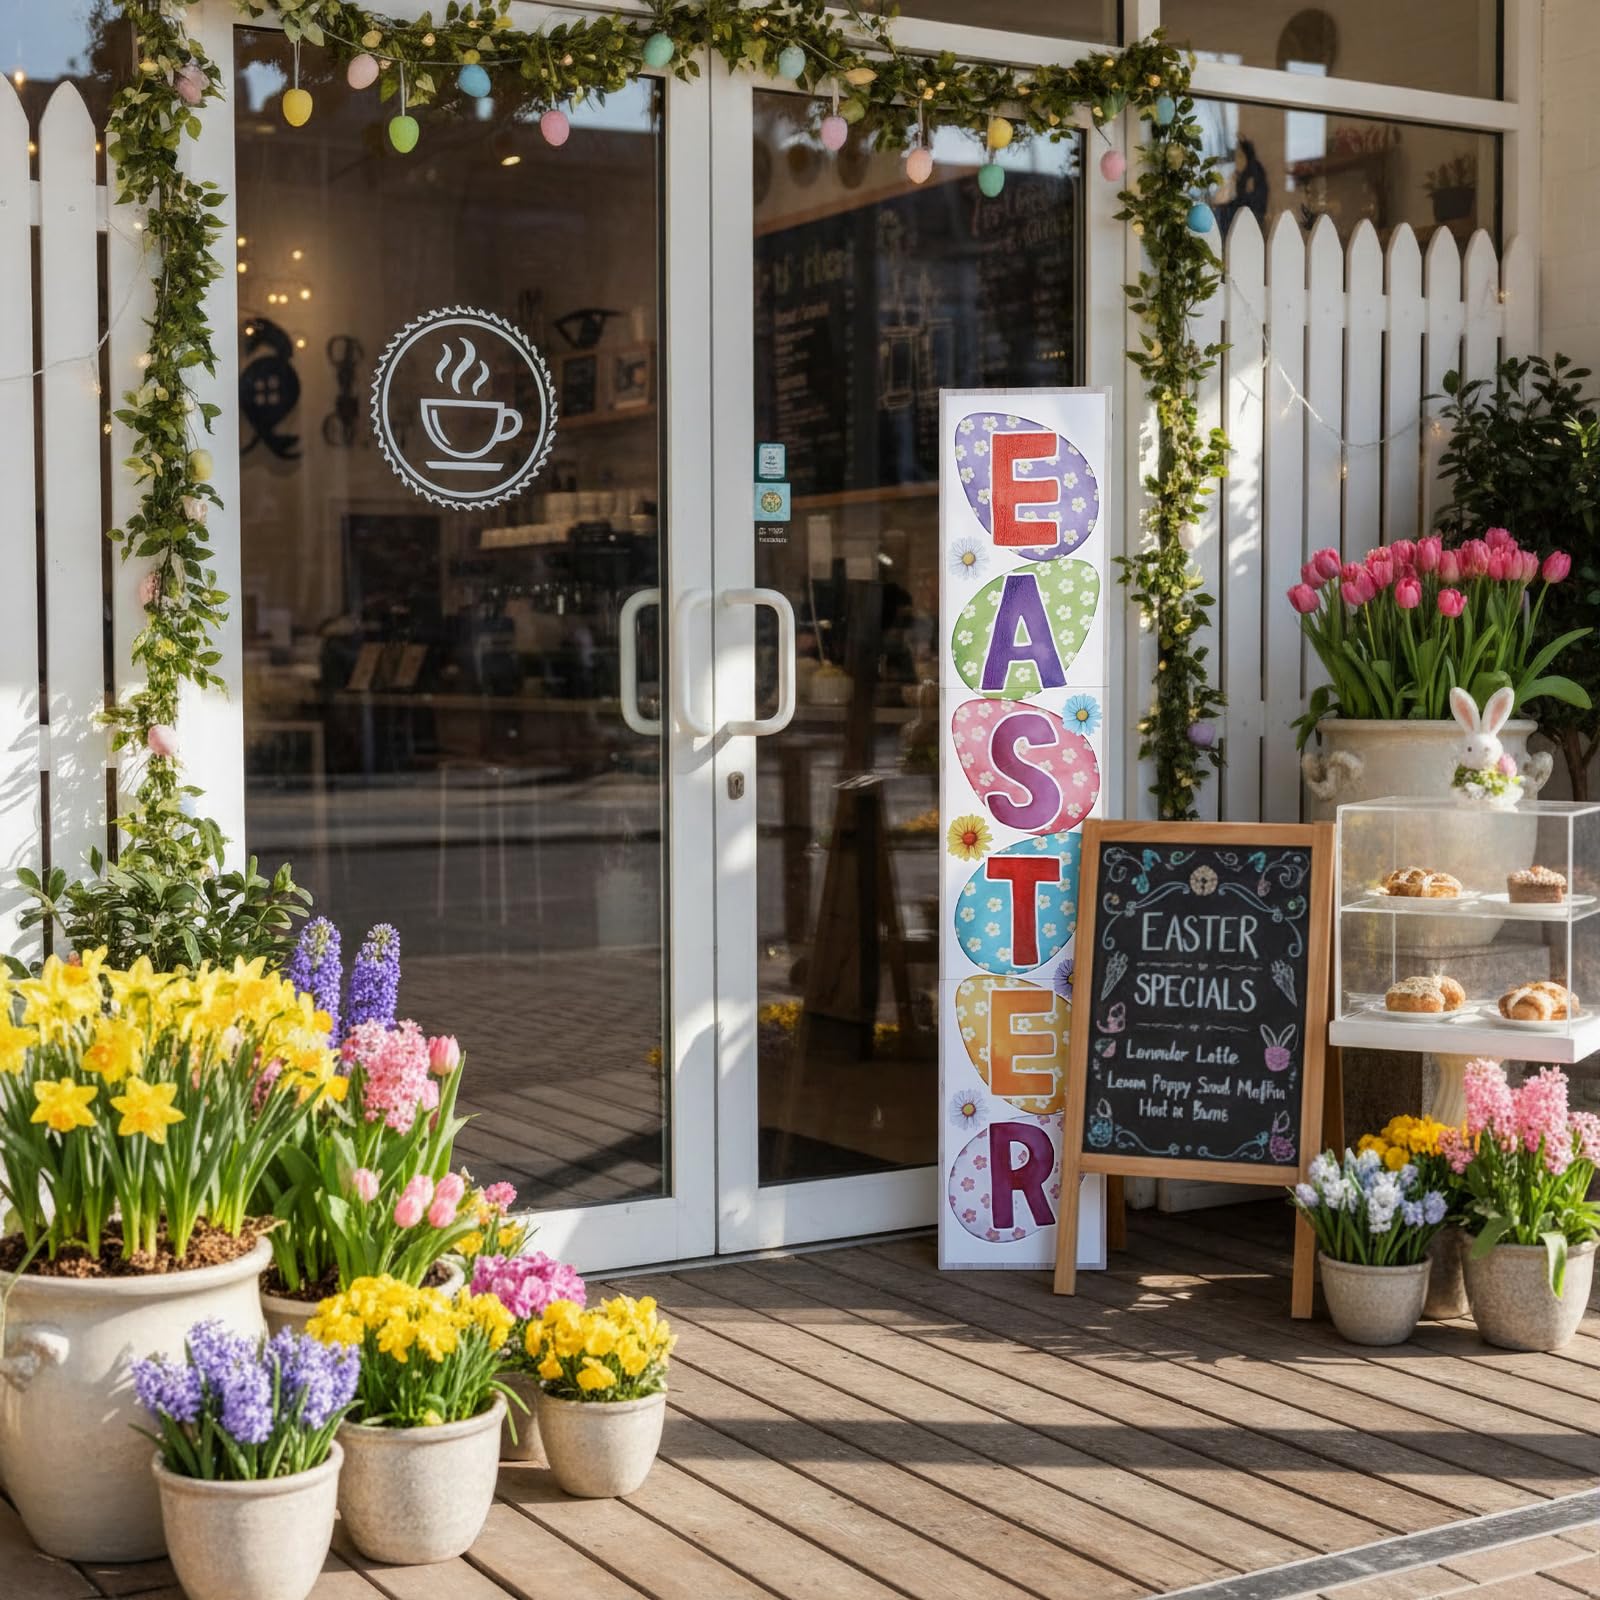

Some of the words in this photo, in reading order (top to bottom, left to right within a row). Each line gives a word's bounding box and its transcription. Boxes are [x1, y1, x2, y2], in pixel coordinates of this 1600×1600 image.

[980, 430, 1068, 1230] EASTER
[1141, 911, 1259, 960] EASTER
[1133, 972, 1257, 1013] SPECIALS
